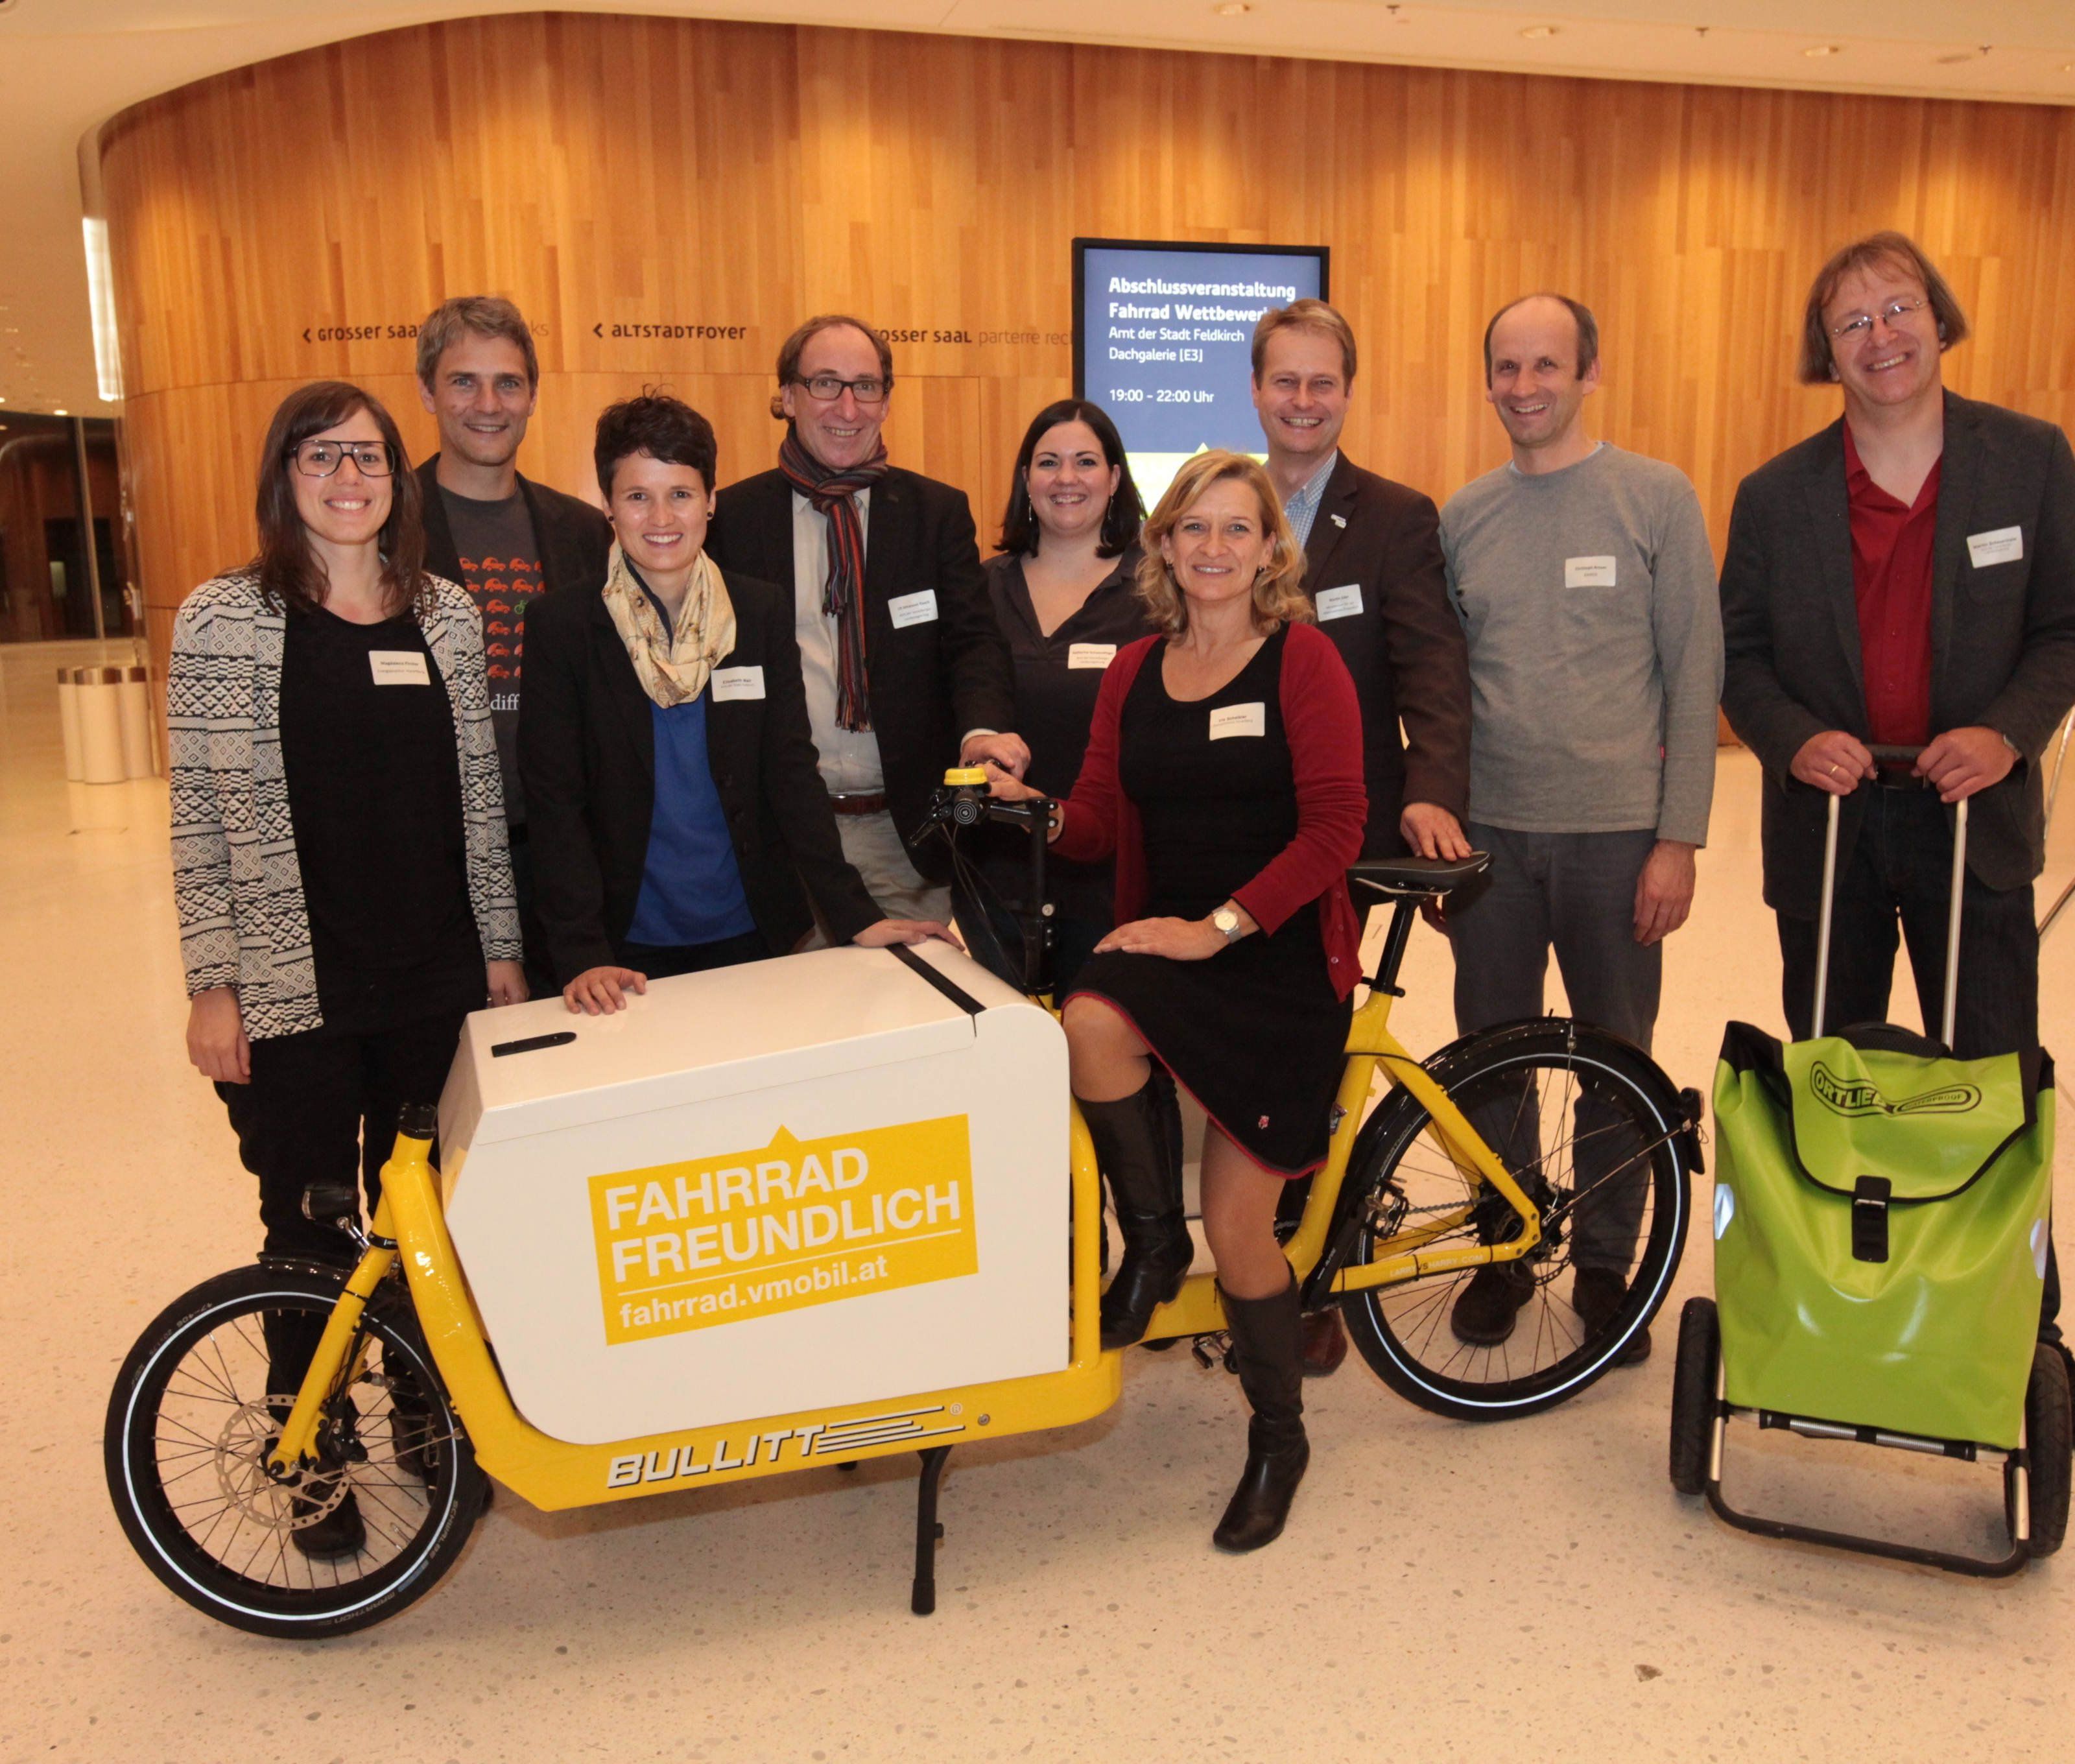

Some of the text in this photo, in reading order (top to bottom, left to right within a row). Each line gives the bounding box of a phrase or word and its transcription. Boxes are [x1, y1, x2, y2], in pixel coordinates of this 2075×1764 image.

[1109, 277, 1296, 302] Abschlussveranstaltung
[1109, 302, 1268, 322] Fahrrad Wettbewer
[387, 324, 421, 339] saa
[978, 329, 1039, 347] parterre
[1045, 330, 1072, 346] rec
[1109, 326, 1245, 342] Amt der Stadt Feldkirch
[1109, 347, 1203, 363] Dachgalerie [E3]
[1109, 389, 1143, 401] 19:00
[1157, 390, 1191, 402] 22:00
[1194, 390, 1215, 403] Uhr
[605, 1147, 869, 1230] FAHRRAD
[611, 1180, 961, 1283] FREUNDLICH
[619, 1255, 888, 1329] fahrrad.vmobil.at
[607, 1424, 826, 1488] BULLITT
